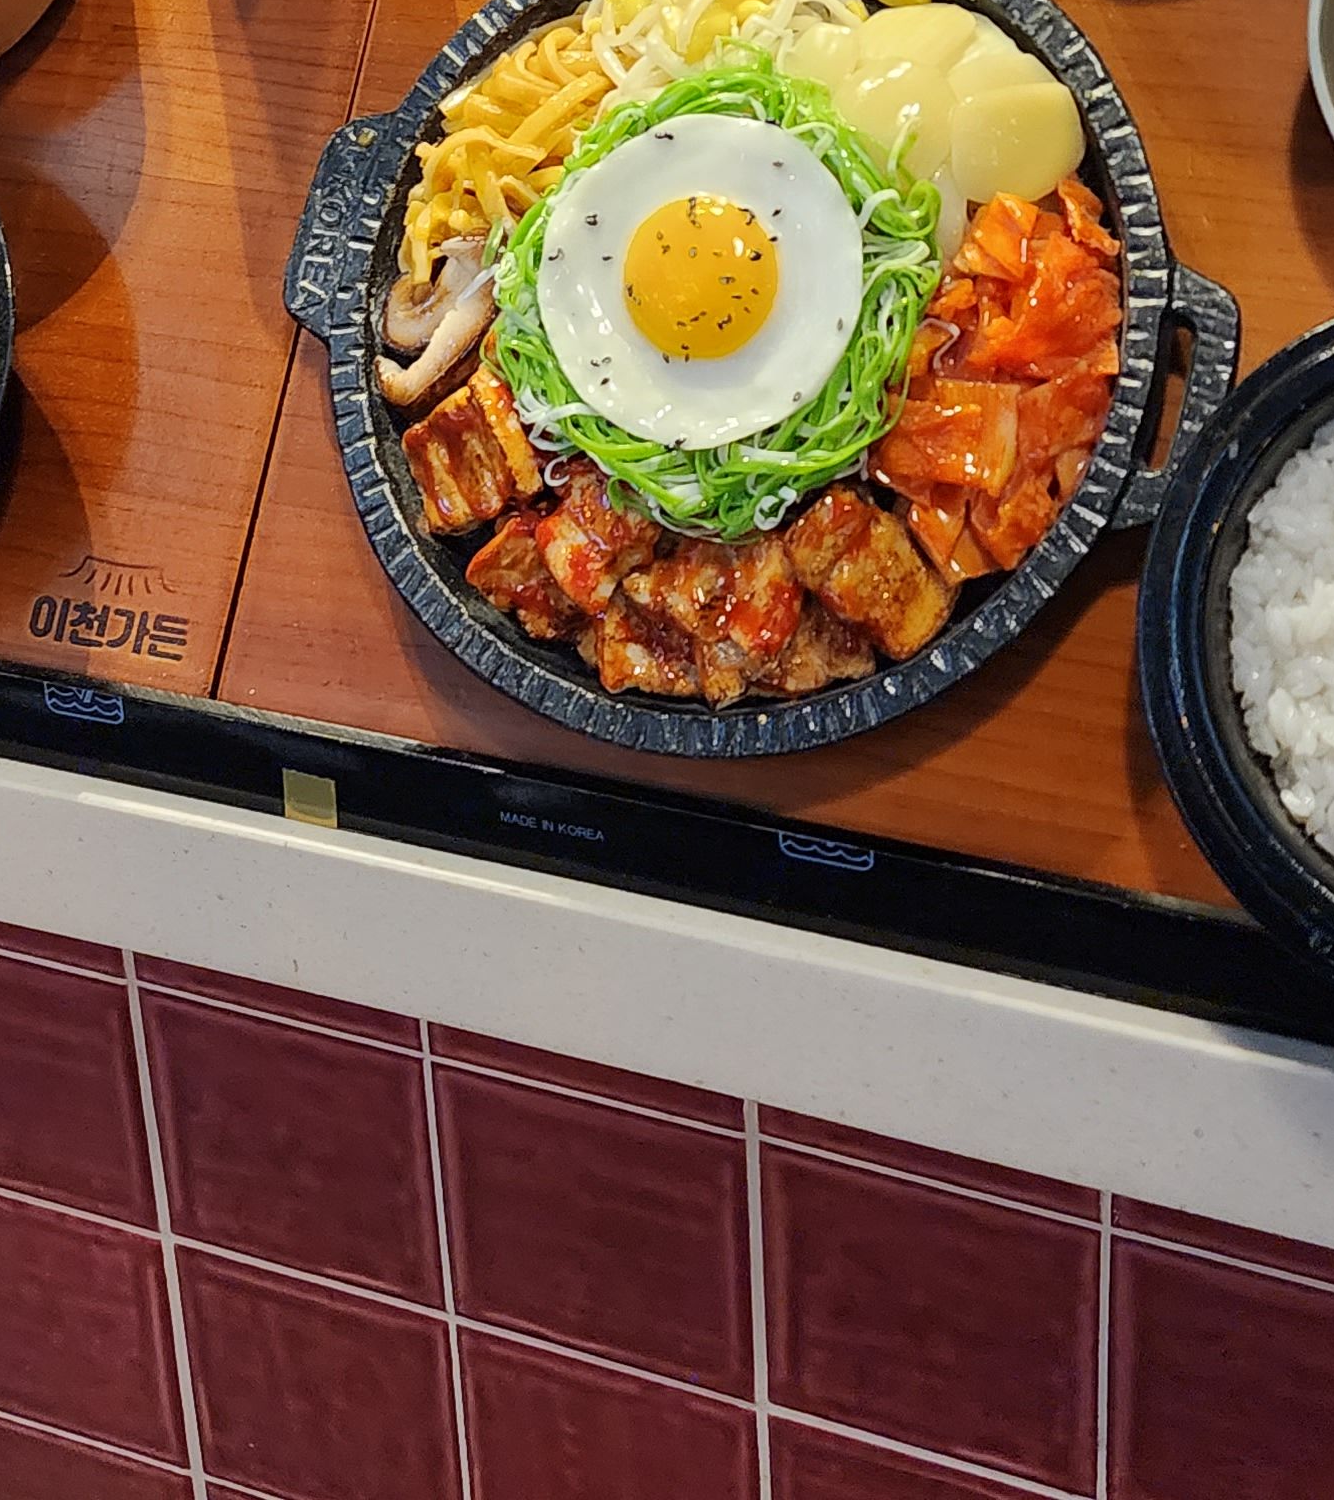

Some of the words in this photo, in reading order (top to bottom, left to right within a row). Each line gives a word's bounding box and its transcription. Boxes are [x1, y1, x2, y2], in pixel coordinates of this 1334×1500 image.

[29, 595, 189, 662] 이천가든
[499, 811, 538, 829] MADE
[541, 820, 554, 832] IN
[558, 823, 605, 842] KOREA
